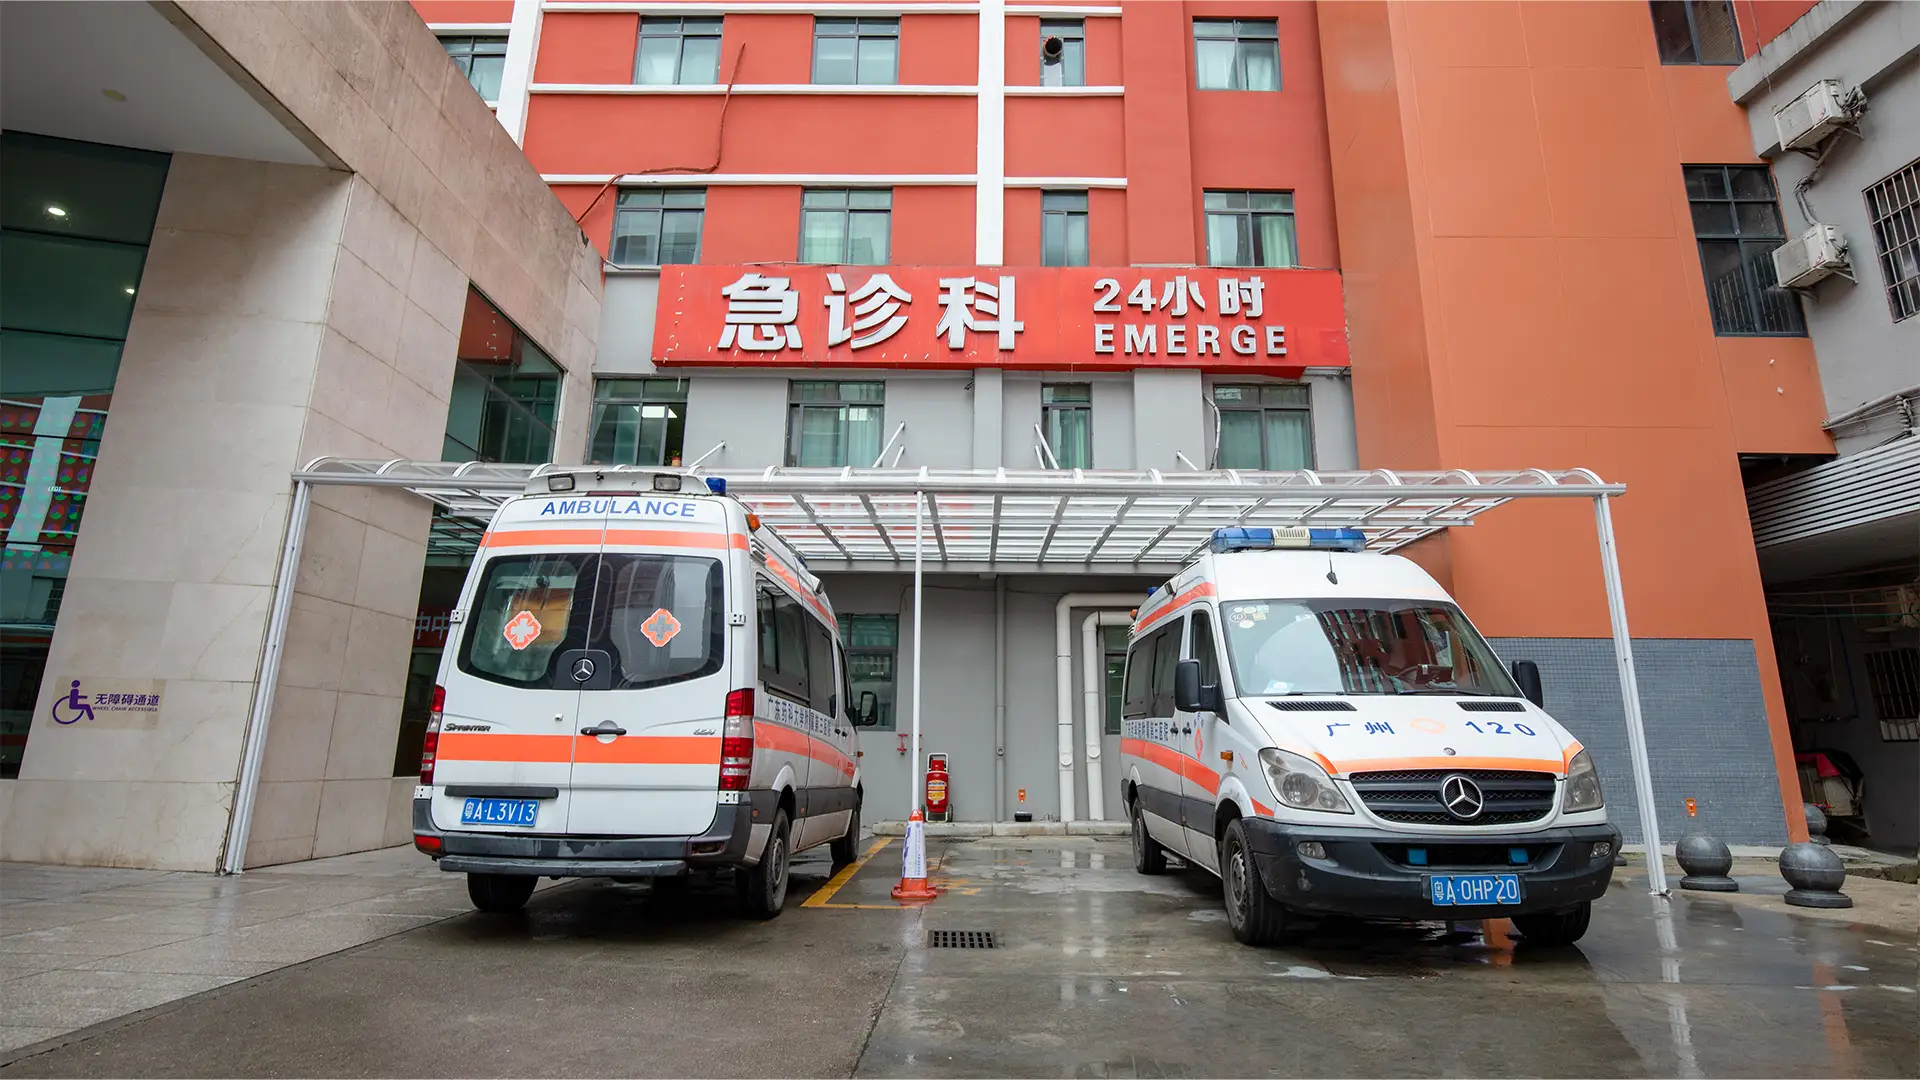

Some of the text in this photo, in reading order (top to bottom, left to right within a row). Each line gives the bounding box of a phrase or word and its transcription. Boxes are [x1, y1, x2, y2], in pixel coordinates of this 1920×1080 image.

[1093, 275, 1265, 317] 24小时
[717, 273, 1025, 350] 急诊科
[1094, 323, 1287, 355] EMERGE
[541, 500, 697, 517] AMBULANCE
[95, 693, 160, 706] 无障碍通道
[1326, 720, 1546, 737] 广州 120
